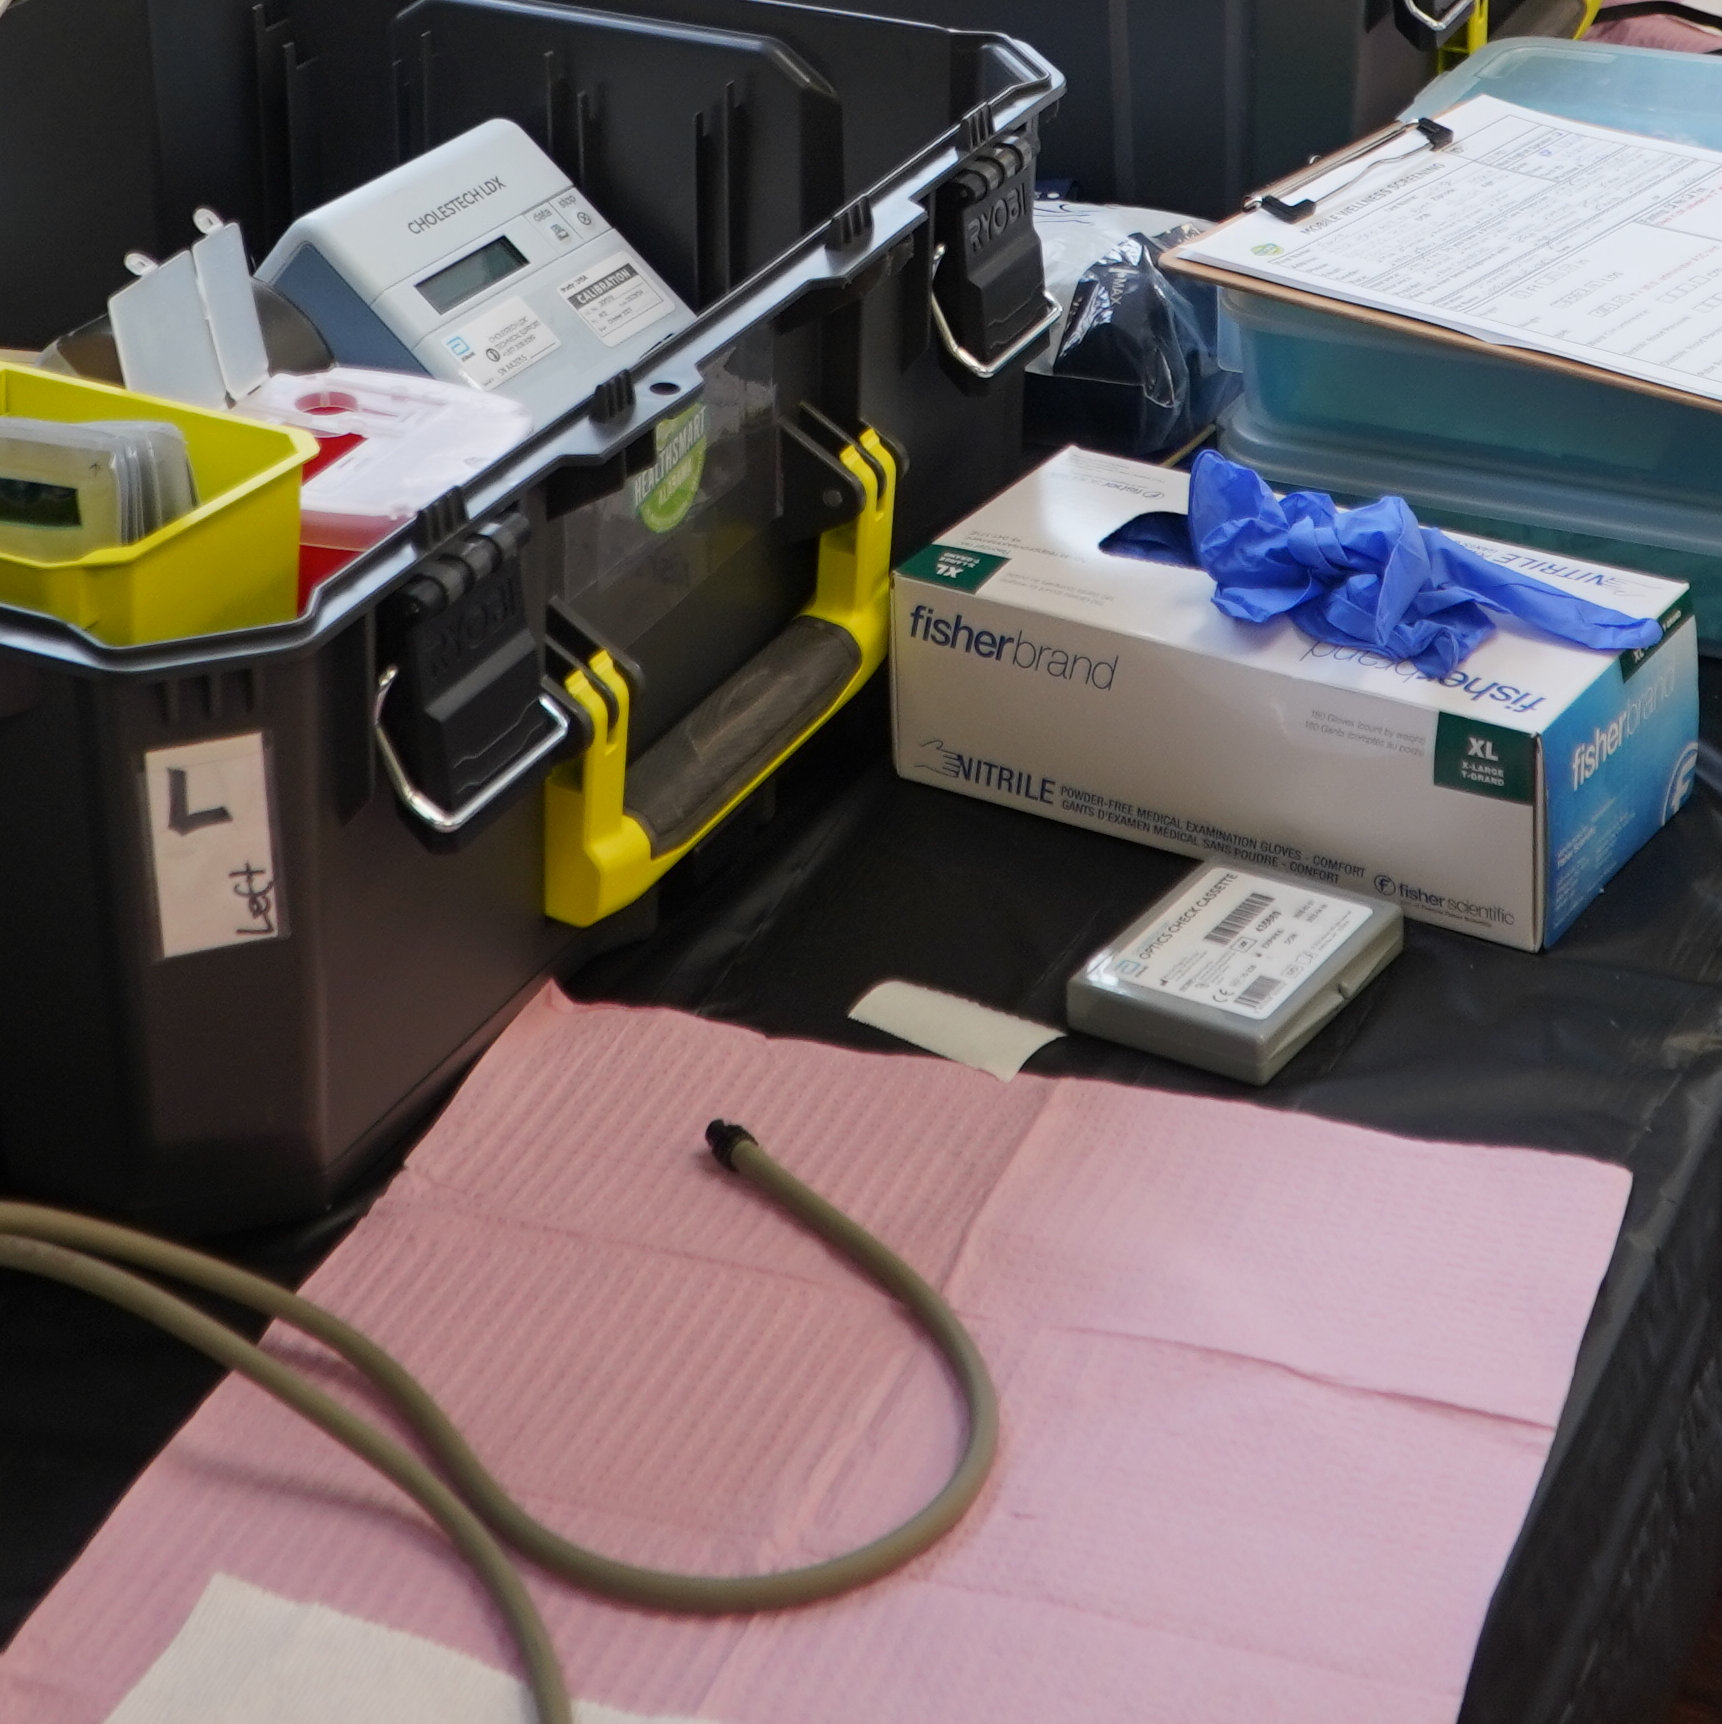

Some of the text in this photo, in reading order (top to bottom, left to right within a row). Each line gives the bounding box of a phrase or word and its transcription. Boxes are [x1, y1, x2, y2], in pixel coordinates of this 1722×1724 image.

[407, 175, 507, 235] CHOLESTECH LDX
[533, 207, 553, 223] data
[558, 194, 577, 210] stop
[1300, 162, 1446, 236] MOBILE WELLNESS SCREENING
[576, 266, 631, 305] CALIBRATION
[633, 405, 708, 507] HEALTHSMART
[936, 564, 964, 580] XL
[1499, 554, 1609, 586] NITRILE
[910, 604, 1119, 692] fisherbrand
[1467, 736, 1499, 762] XL
[1571, 664, 1677, 792] fisherbrand
[957, 752, 1056, 805] NITRILE
[1461, 760, 1505, 778] X-LARGE
[1461, 769, 1505, 787] T-GRAND
[168, 767, 233, 837] L
[1060, 785, 1134, 816] POWDER-FREE
[1137, 806, 1183, 830] MEDICAL
[1185, 819, 1257, 851] EXAMINATION
[1259, 838, 1302, 862] GLOVES
[1312, 853, 1367, 879] COMFORT
[1061, 799, 1095, 818] GANTS
[1097, 808, 1151, 833] D'EXAMEN
[1203, 837, 1232, 856] SANS
[1234, 846, 1279, 868] POUDRE
[1289, 860, 1341, 885] CONFORT
[228, 861, 275, 936] Left
[1139, 871, 1240, 961] OPTICS CHECK CASSETTE
[1397, 881, 1447, 909] fisher
[1446, 896, 1516, 927] scientific
